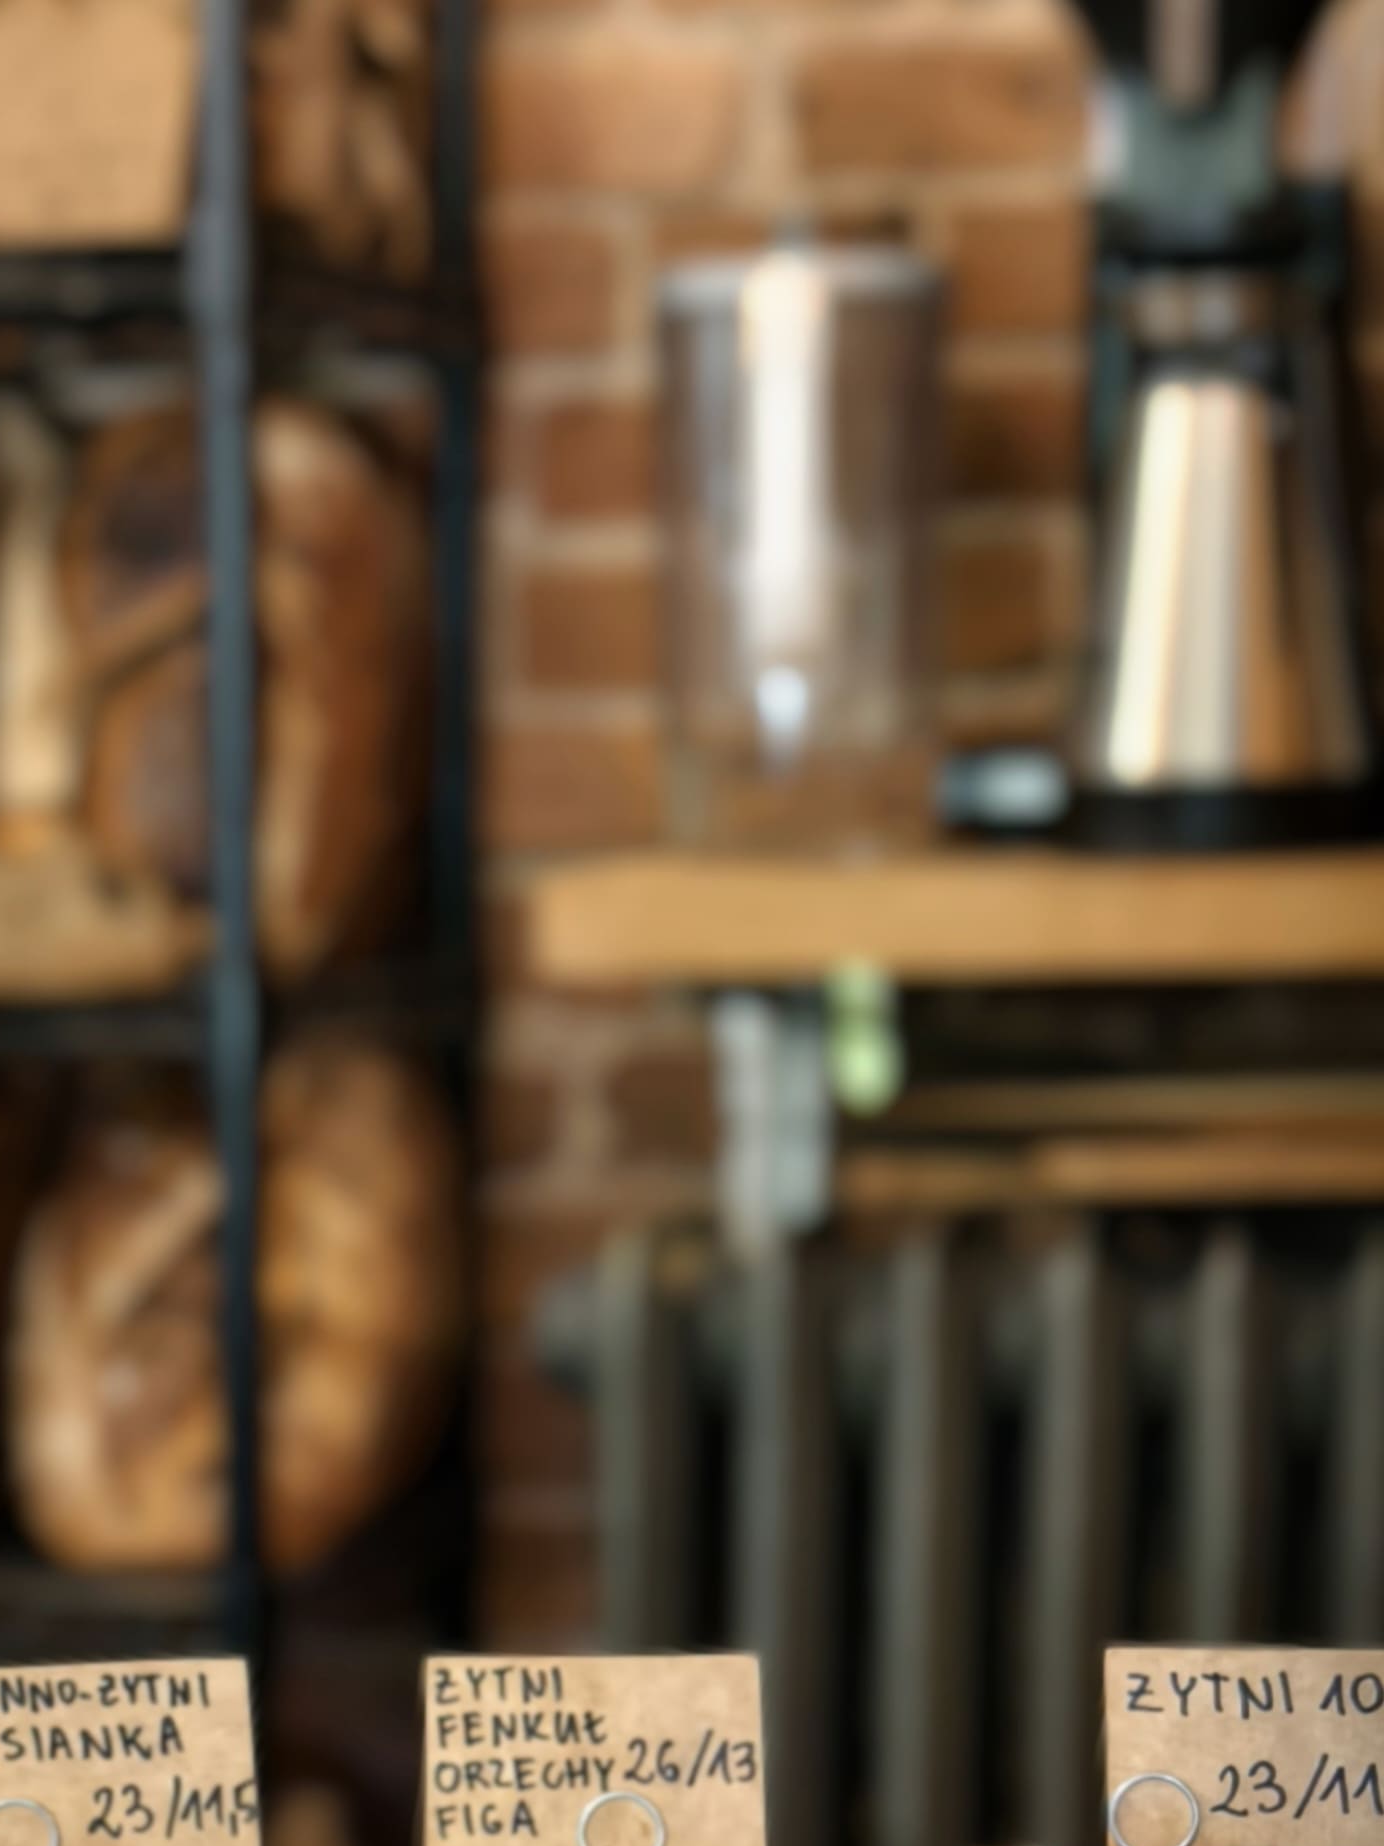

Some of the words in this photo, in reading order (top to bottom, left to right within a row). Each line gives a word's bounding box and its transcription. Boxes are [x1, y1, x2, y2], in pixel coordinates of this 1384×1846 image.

[436, 1711, 608, 1748] FENKUŁ
[433, 1756, 615, 1793] ORZECHY
[623, 1728, 758, 1787] 26/13
[87, 1775, 256, 1839] 23/11,5
[434, 1800, 539, 1839] FIGA
